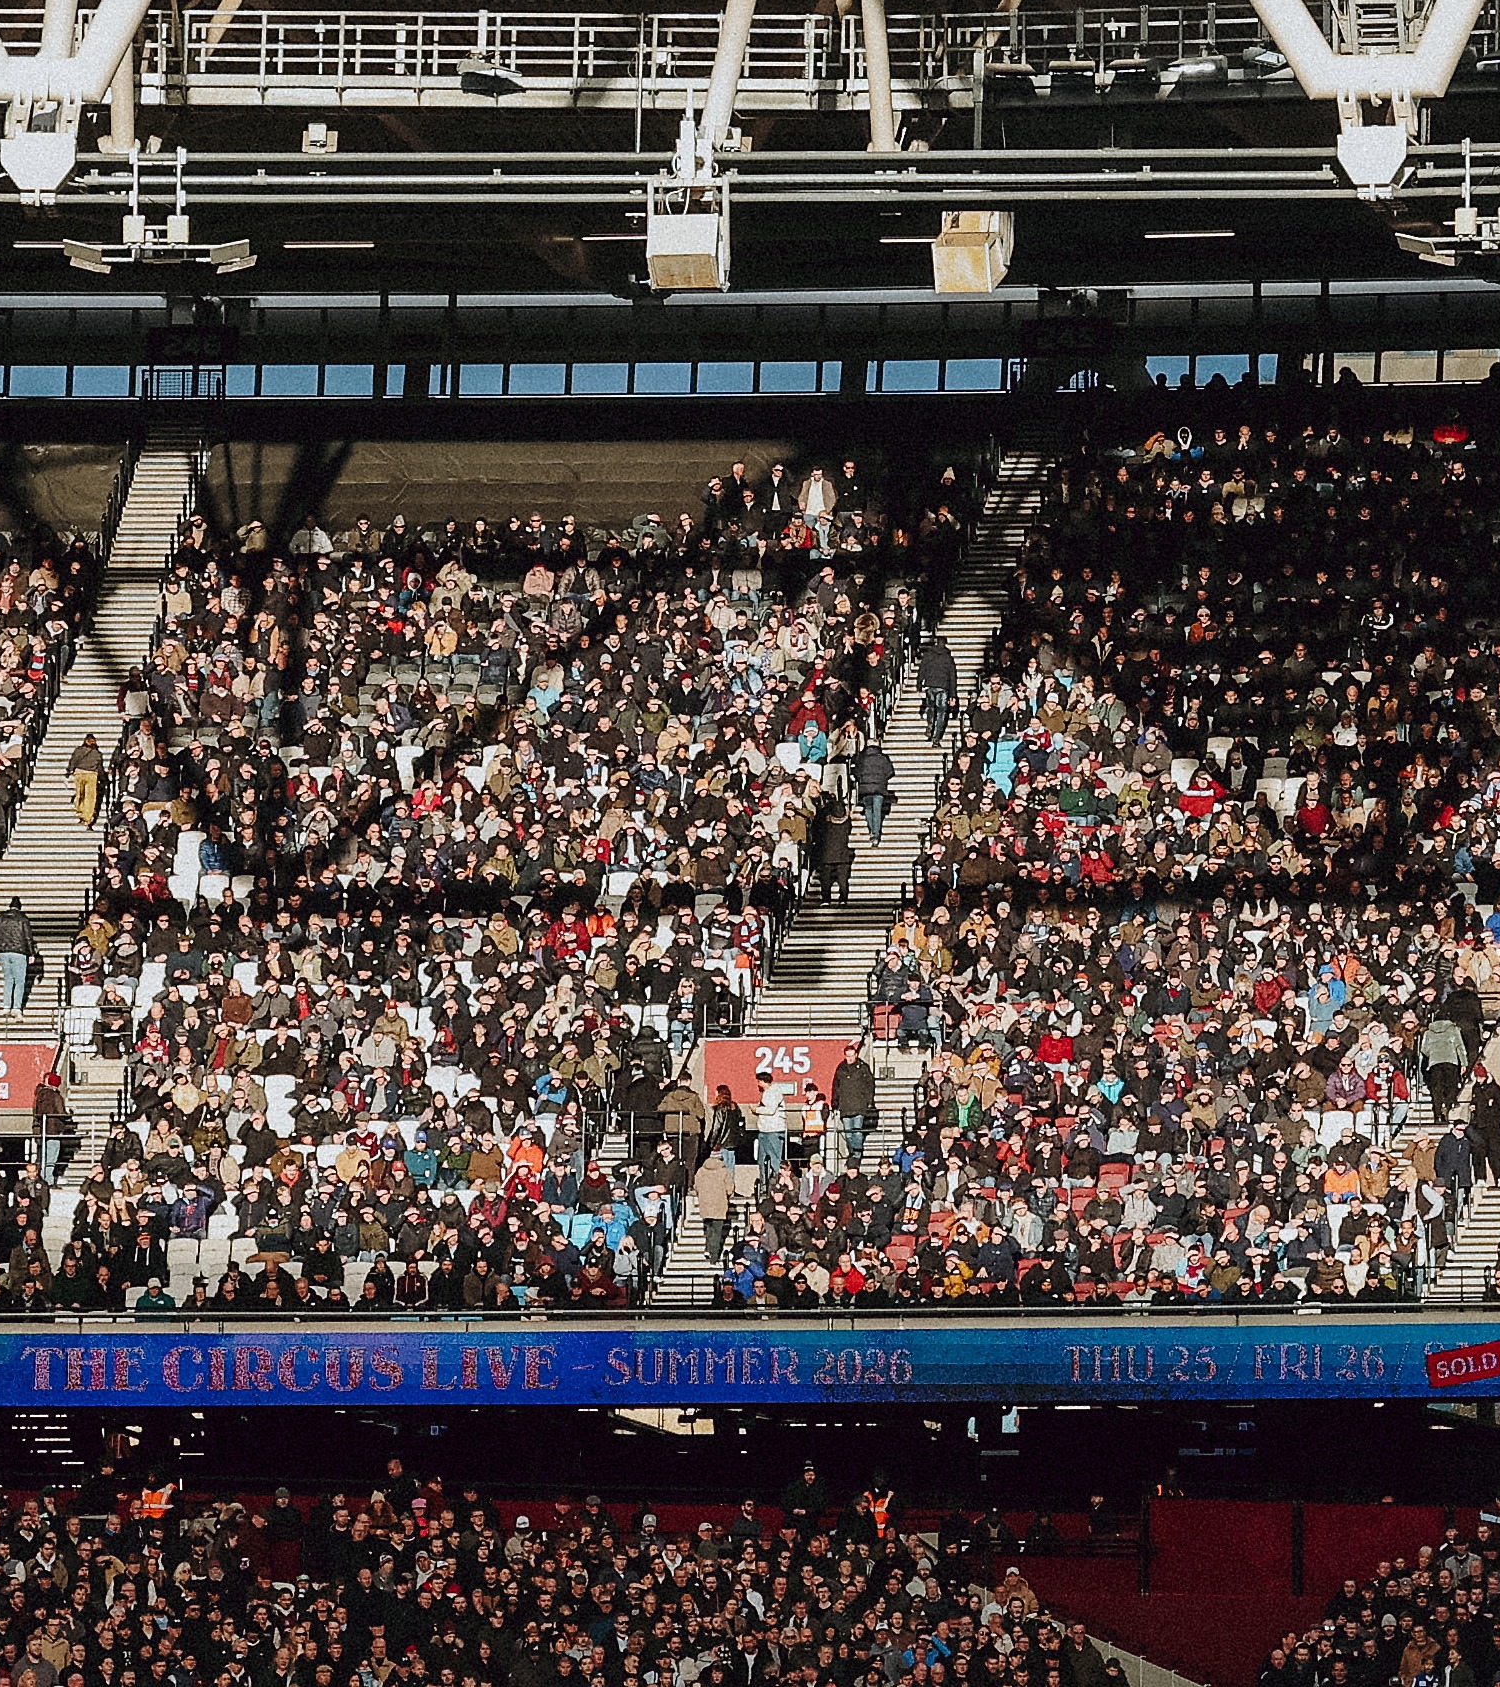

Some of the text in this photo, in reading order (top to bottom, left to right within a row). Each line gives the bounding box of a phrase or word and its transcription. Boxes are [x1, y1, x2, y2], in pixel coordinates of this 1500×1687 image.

[755, 1046, 811, 1074] 245
[20, 1346, 149, 1392] THE
[162, 1345, 404, 1392] CIRCUS
[419, 1345, 559, 1391] LIVE
[603, 1346, 801, 1386] SUMMER
[812, 1348, 913, 1386] 2026
[1063, 1344, 1153, 1383] THU
[1167, 1345, 1219, 1382] 25
[1252, 1342, 1323, 1381] FRI
[1335, 1344, 1386, 1381] 26
[1436, 1352, 1498, 1379] SOLD
